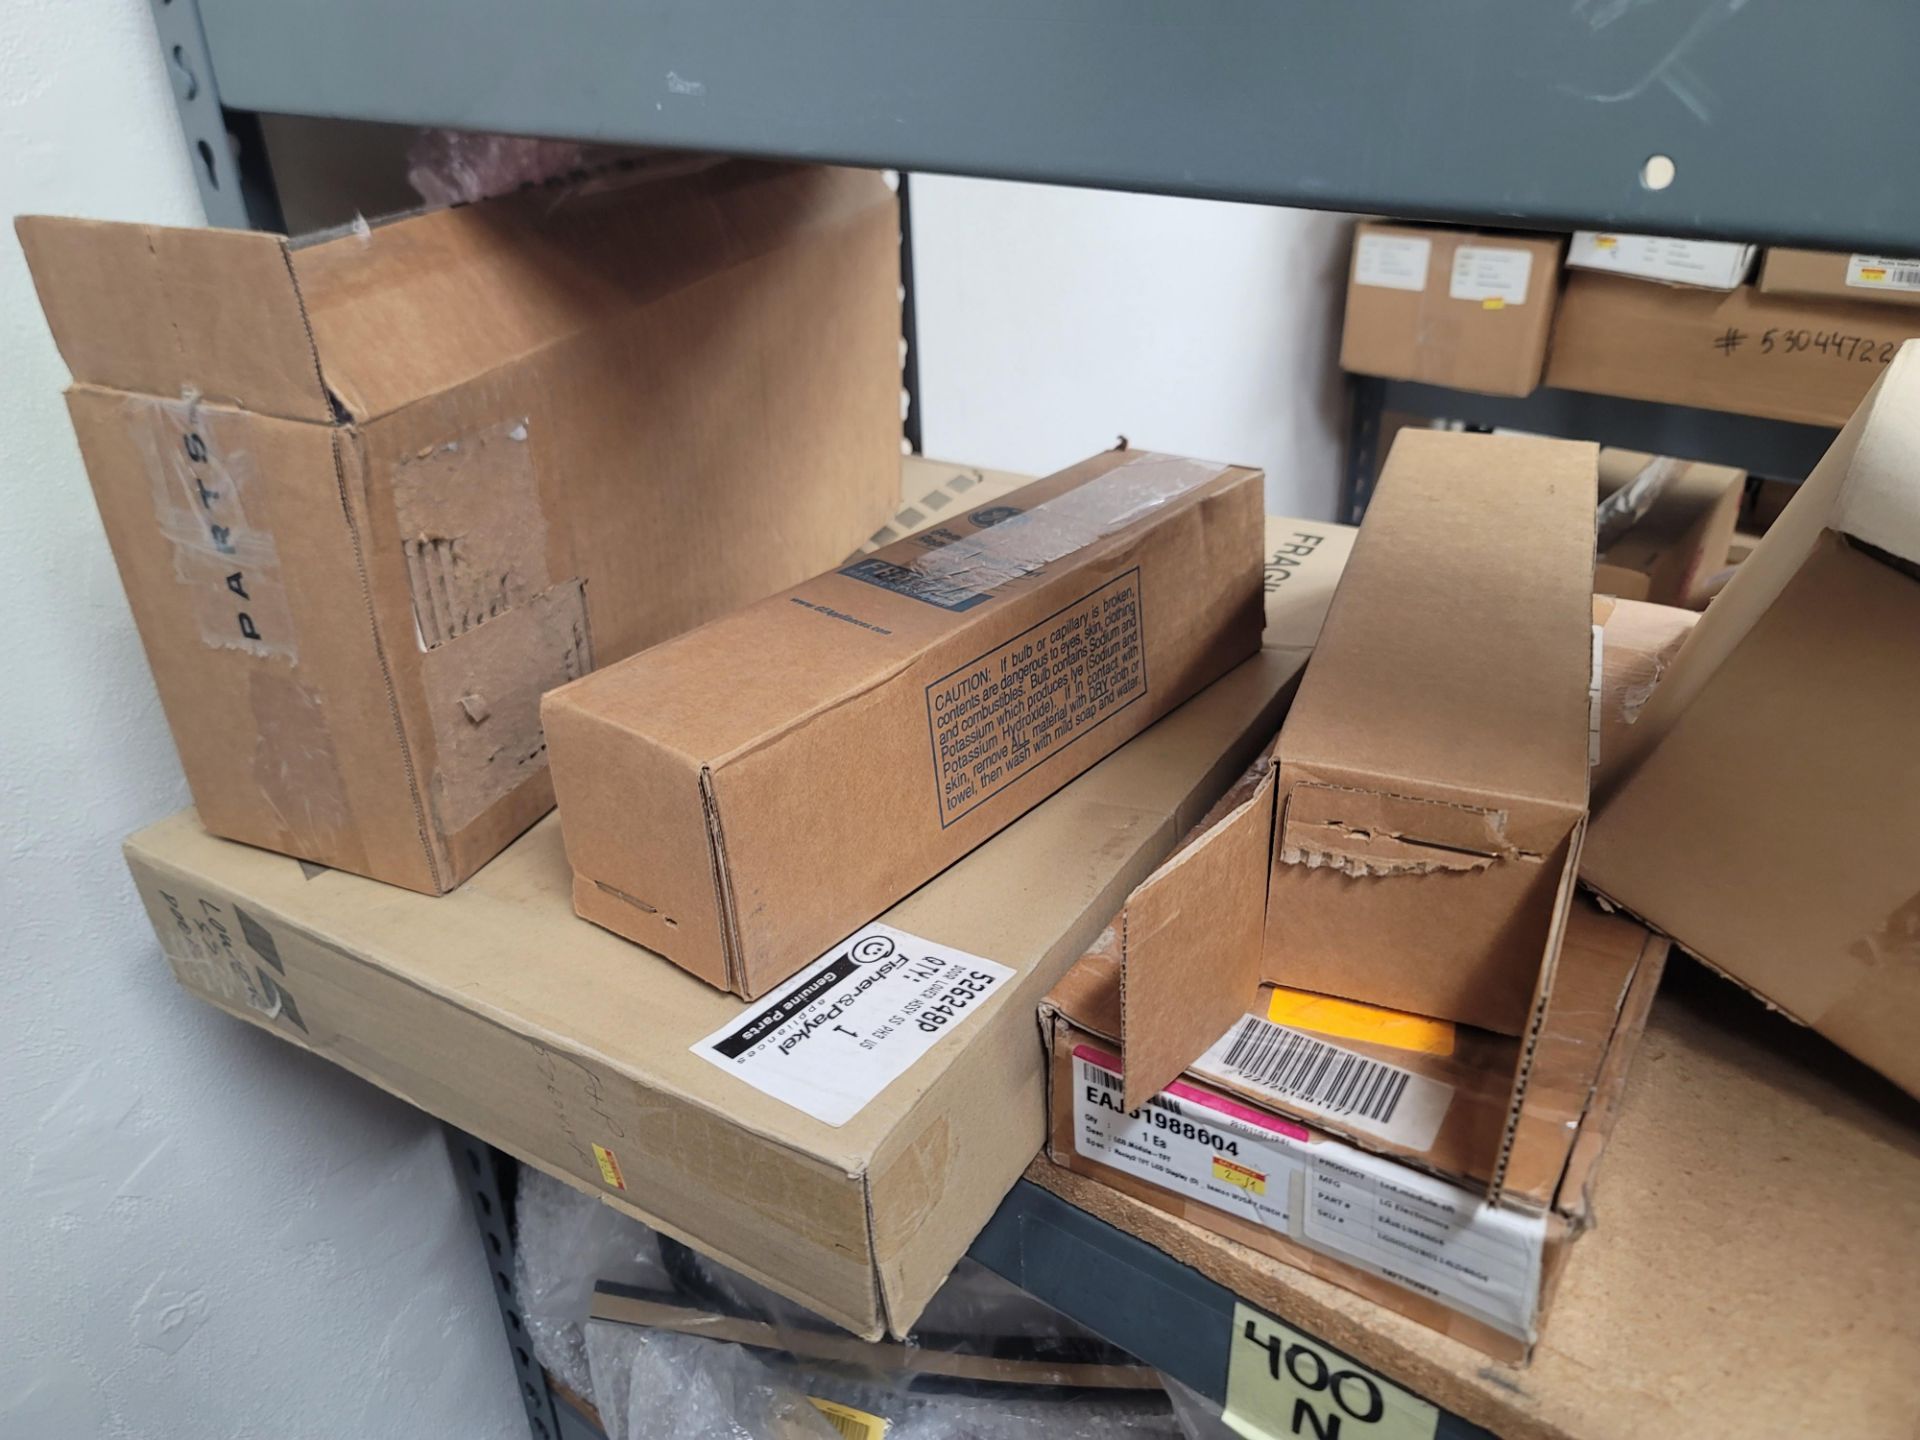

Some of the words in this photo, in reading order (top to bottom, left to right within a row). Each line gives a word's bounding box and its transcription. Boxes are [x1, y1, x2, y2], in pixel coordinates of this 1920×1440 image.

[1714, 325, 1746, 356] #
[183, 432, 262, 641] PARTS
[935, 668, 991, 710] CAUTION:
[1000, 656, 1006, 673] If
[1011, 644, 1032, 666] bulb
[1036, 637, 1045, 652] or
[1049, 612, 1088, 643] capillary
[1091, 606, 1099, 618] is
[1102, 587, 1134, 612] broken,
[937, 694, 980, 728] contents
[982, 683, 998, 701] are
[1000, 652, 1047, 692] dangerous
[1049, 646, 1058, 660] to
[1060, 633, 1082, 654] eyes,
[1084, 621, 1103, 639] skin,
[1104, 600, 1135, 627] clothing
[939, 721, 958, 745] and
[961, 681, 1025, 730] combustibles.
[1030, 666, 1050, 688] Bulb
[1052, 645, 1087, 674] contains
[1089, 625, 1119, 652] Sodium
[1121, 612, 1136, 633] and
[941, 720, 994, 761] Potassium
[996, 699, 1024, 726] which
[1027, 673, 1067, 710] produces
[1070, 664, 1083, 682] lye
[1085, 641, 1120, 671] (Sodium
[1122, 628, 1137, 648] and
[943, 735, 997, 777] Potassium
[1002, 697, 1056, 739] Hydroxide).
[1064, 685, 1070, 699] If
[1074, 679, 1083, 693] in
[1087, 656, 1118, 685] contact
[1121, 644, 1138, 663] with
[945, 772, 969, 794] skin,
[972, 745, 1008, 776] remove
[1011, 730, 1029, 751] ALL
[1032, 703, 1067, 737] material
[1069, 693, 1086, 712] with
[1088, 677, 1108, 701] DRY
[1110, 666, 1128, 686] cloth
[1130, 659, 1138, 672] or
[946, 781, 977, 810] towel,
[980, 766, 1002, 788] then
[1005, 746, 1030, 771] wash
[1032, 732, 1051, 752] with
[1054, 716, 1072, 739] mild
[1075, 704, 1095, 725] soap
[1098, 689, 1114, 710] and
[1116, 675, 1140, 697] water.
[903, 956, 945, 982] QTY:
[943, 964, 966, 979] DOOR
[779, 954, 908, 1054] Fisher&Paykel
[783, 972, 836, 1009] Genuine
[903, 999, 923, 1014] ASSY
[917, 971, 993, 1031] 526248P
[920, 980, 947, 998] LOWER
[737, 998, 825, 1063] appliances
[742, 1010, 783, 1039] Parts
[832, 1024, 857, 1037] 1
[871, 1026, 893, 1039] PH3
[888, 1015, 905, 1025] SS
[859, 1039, 873, 1049] US
[1141, 1131, 1147, 1142] 1
[1153, 1135, 1166, 1150] Ea
[1318, 1173, 1340, 1188] MFG
[1244, 1320, 1384, 1424] 400
[1291, 1398, 1341, 1440] N
